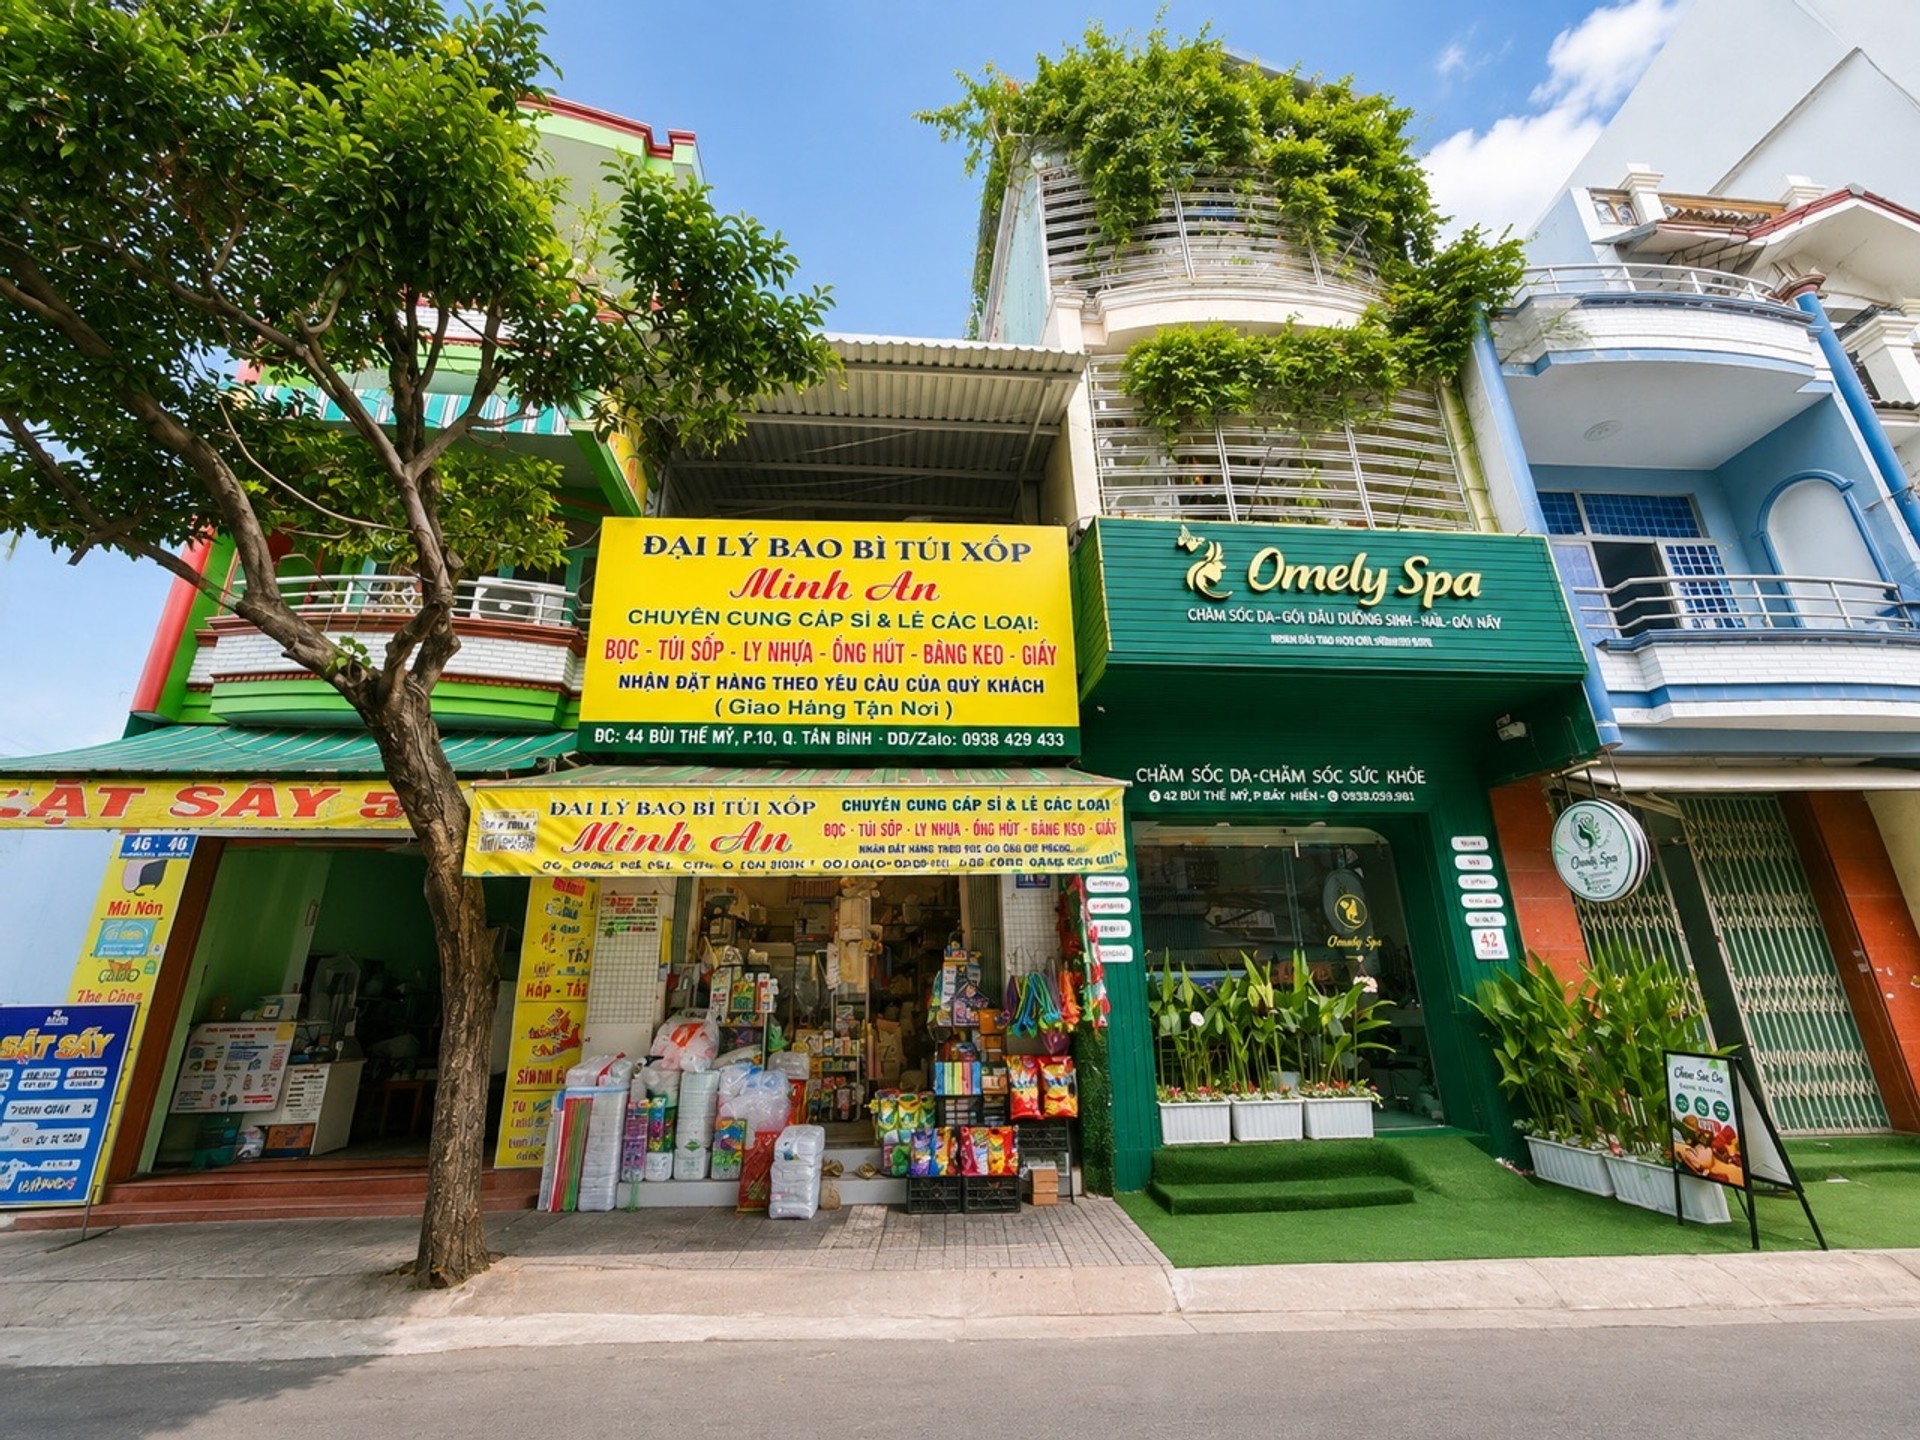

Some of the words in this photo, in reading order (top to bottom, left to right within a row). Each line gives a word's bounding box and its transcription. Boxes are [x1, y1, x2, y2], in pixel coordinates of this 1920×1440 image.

[643, 535, 706, 560] ĐẠI
[717, 532, 759, 558] LÝ
[768, 538, 843, 559] BAO
[853, 535, 886, 560] BÌ
[895, 536, 951, 562] TÚI
[961, 534, 1032, 563] XỐP
[729, 567, 853, 601] Minh
[865, 569, 940, 601] An
[1248, 547, 1389, 606] Omely
[1398, 555, 1482, 609] Spa
[628, 607, 720, 625] CHUYÊN
[727, 610, 792, 627] CUNG
[877, 614, 891, 628] &
[984, 615, 1039, 634] LOẠI:
[604, 638, 640, 664] BỌC
[658, 635, 686, 661] TÚI
[691, 631, 725, 662] SỐP
[743, 641, 762, 662] LY
[768, 639, 813, 667] NHỰA
[972, 643, 1004, 665] KEO
[618, 671, 670, 692] NHẬN
[772, 676, 819, 691] THEO
[729, 698, 781, 715] Giao
[901, 701, 939, 717] Nơi
[594, 728, 620, 744] ĐC:
[625, 729, 644, 744] 44
[649, 726, 675, 744] BÙI
[783, 730, 797, 746] Q.
[962, 731, 999, 748] 0938
[1004, 732, 1032, 748] 429
[1037, 732, 1065, 748] 433
[1136, 764, 1185, 783] CHĂM
[1312, 765, 1344, 784] SÓC
[906, 799, 947, 812] CUNG
[1006, 797, 1017, 811] &
[1163, 790, 1178, 802] 42
[636, 801, 686, 816] BAO
[561, 821, 695, 854] Minh
[709, 821, 793, 854] An
[915, 823, 927, 837] LY
[131, 837, 151, 850] 46
[1479, 932, 1498, 948] 42
